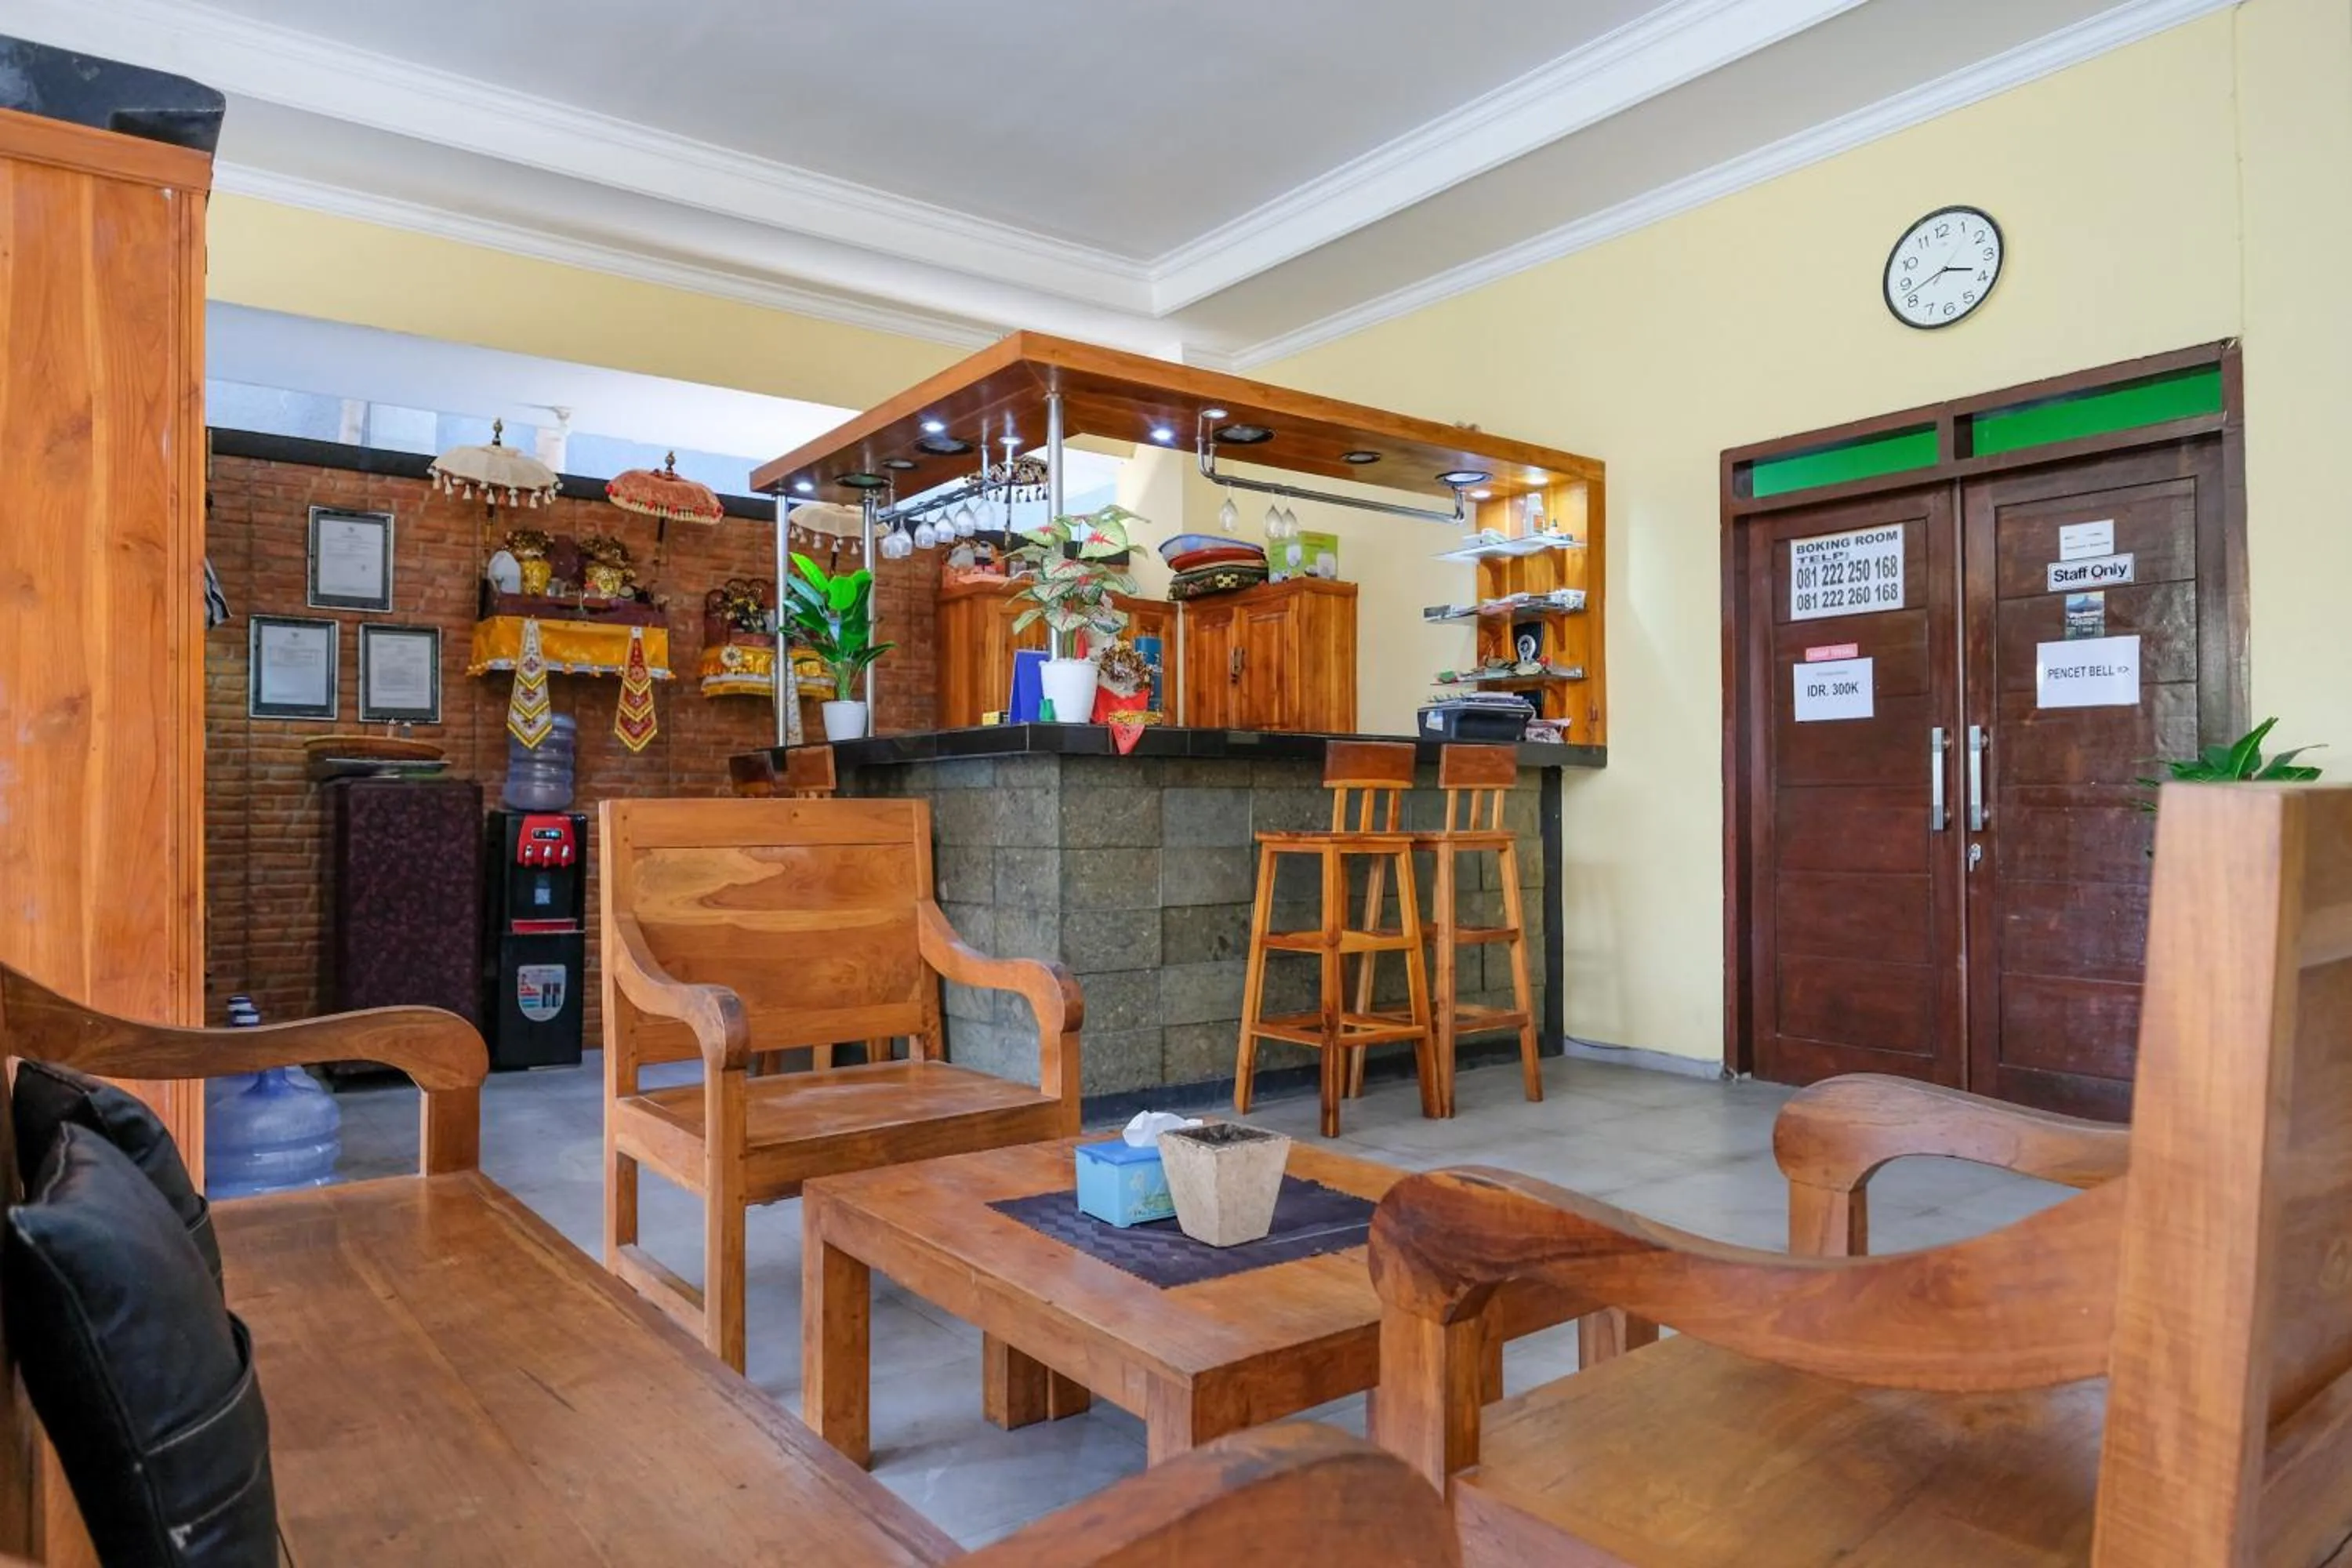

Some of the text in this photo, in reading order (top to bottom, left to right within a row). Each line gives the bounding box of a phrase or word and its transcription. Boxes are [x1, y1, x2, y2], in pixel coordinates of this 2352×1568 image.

[1934, 224, 1950, 238] 12
[1961, 222, 1965, 232] 1
[1918, 235, 1929, 249] 11
[1973, 230, 1985, 244] 2
[1983, 248, 1994, 261] 3
[1903, 256, 1918, 271] 10
[1976, 270, 1988, 281] 4
[1900, 278, 1911, 291] 9
[1907, 294, 1918, 308] 8
[1962, 291, 1975, 304] 5
[1924, 303, 1934, 315] 7
[1943, 302, 1955, 315] 6
[1796, 530, 1898, 554] BOKING ROOM
[1796, 554, 1898, 590] 081 222 250 168
[2054, 562, 2127, 583] Staff Only
[1796, 583, 1898, 611] 081 222 260 168
[2047, 665, 2114, 680] PENCET BELL
[1807, 681, 1859, 697] IDR. 300K
